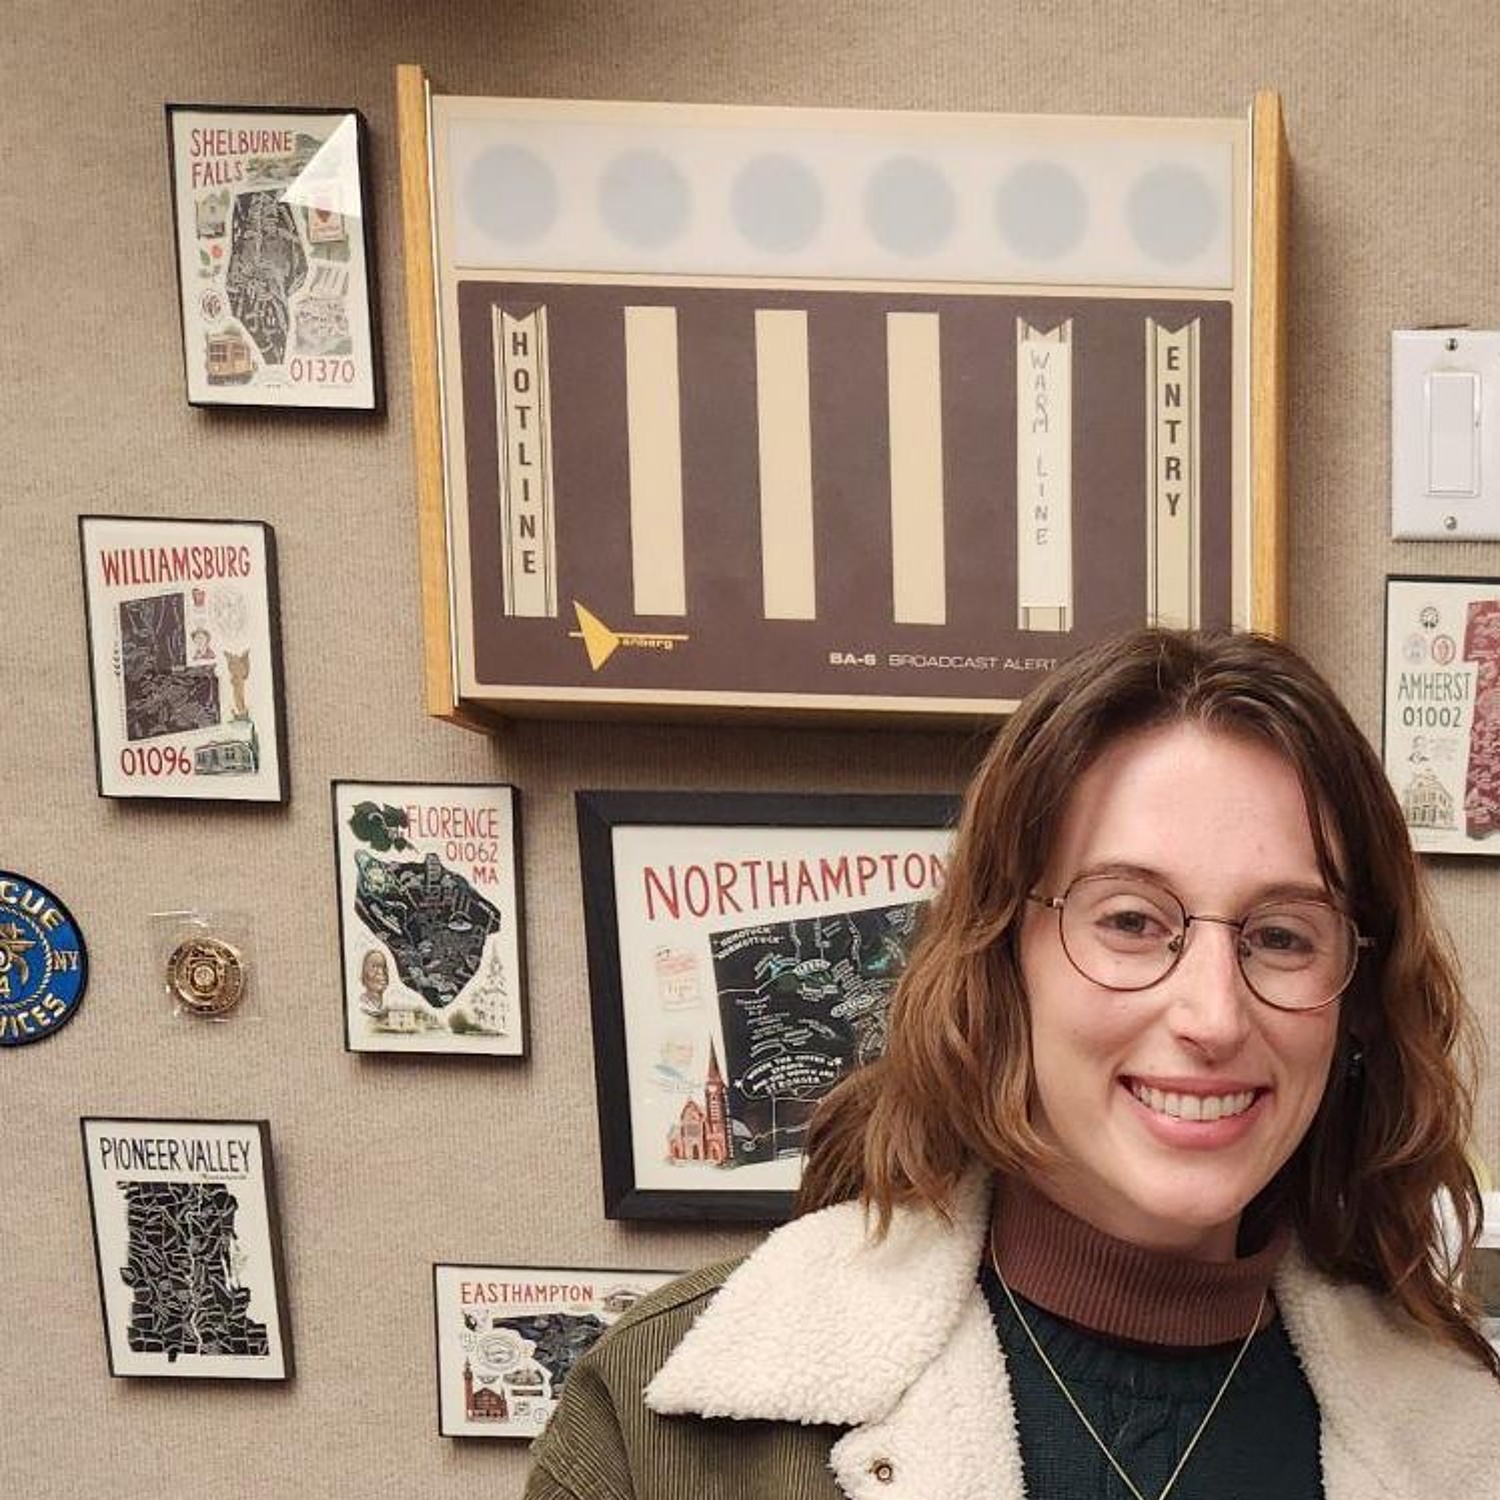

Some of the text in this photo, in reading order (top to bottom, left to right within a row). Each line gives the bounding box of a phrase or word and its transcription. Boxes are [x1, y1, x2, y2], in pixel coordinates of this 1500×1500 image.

[190, 128, 293, 157] SHELBURNE
[191, 161, 244, 189] FALLS
[290, 358, 356, 384] 01370
[1030, 351, 1050, 434] WARM
[1164, 346, 1182, 517] ENTRY
[511, 331, 537, 575] HOTLINE
[1034, 456, 1049, 546] LINE
[100, 546, 251, 586] WILLIAMSBURG
[829, 652, 1057, 671] BA-6 BROADCAST ALERT
[1398, 672, 1471, 702] AMHERST
[1403, 706, 1462, 728] 01002
[121, 746, 192, 777] 01096
[406, 804, 499, 839] FLORENCE
[446, 841, 498, 863] 01062
[472, 865, 499, 884] MA
[52, 950, 79, 972] NY
[100, 1137, 251, 1173] PIONEER VALLEY
[460, 1283, 594, 1304] EASTHAMPTON
